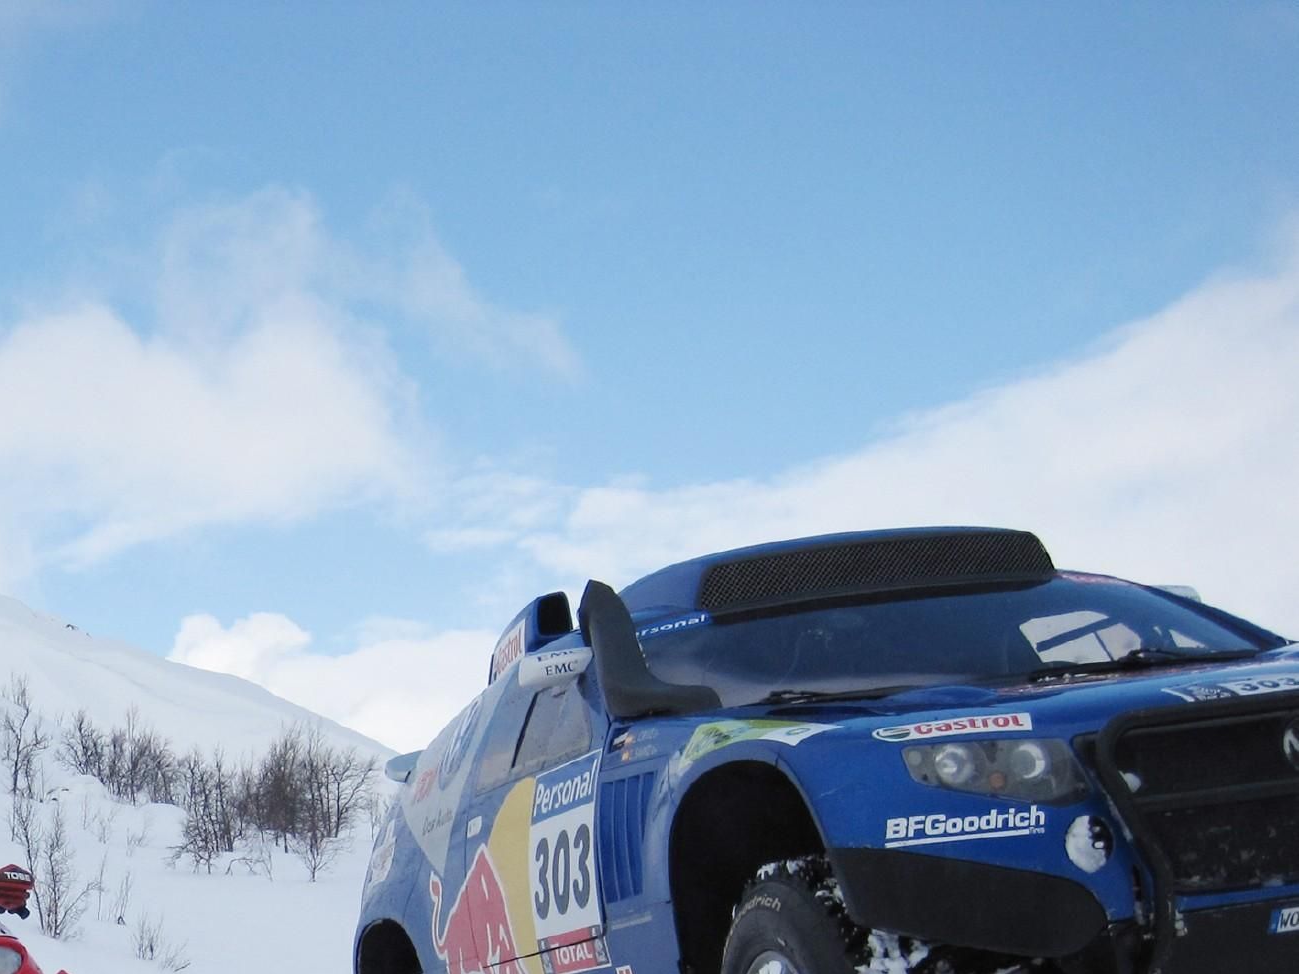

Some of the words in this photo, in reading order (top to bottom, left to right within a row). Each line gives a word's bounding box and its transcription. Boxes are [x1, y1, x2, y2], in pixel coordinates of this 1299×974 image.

[546, 661, 575, 677] EMC
[914, 715, 1024, 735] Castrol
[533, 768, 594, 817] Personal
[885, 805, 1045, 839] BFGoodrich
[534, 824, 591, 920] 303
[553, 943, 593, 966] TOTAL
